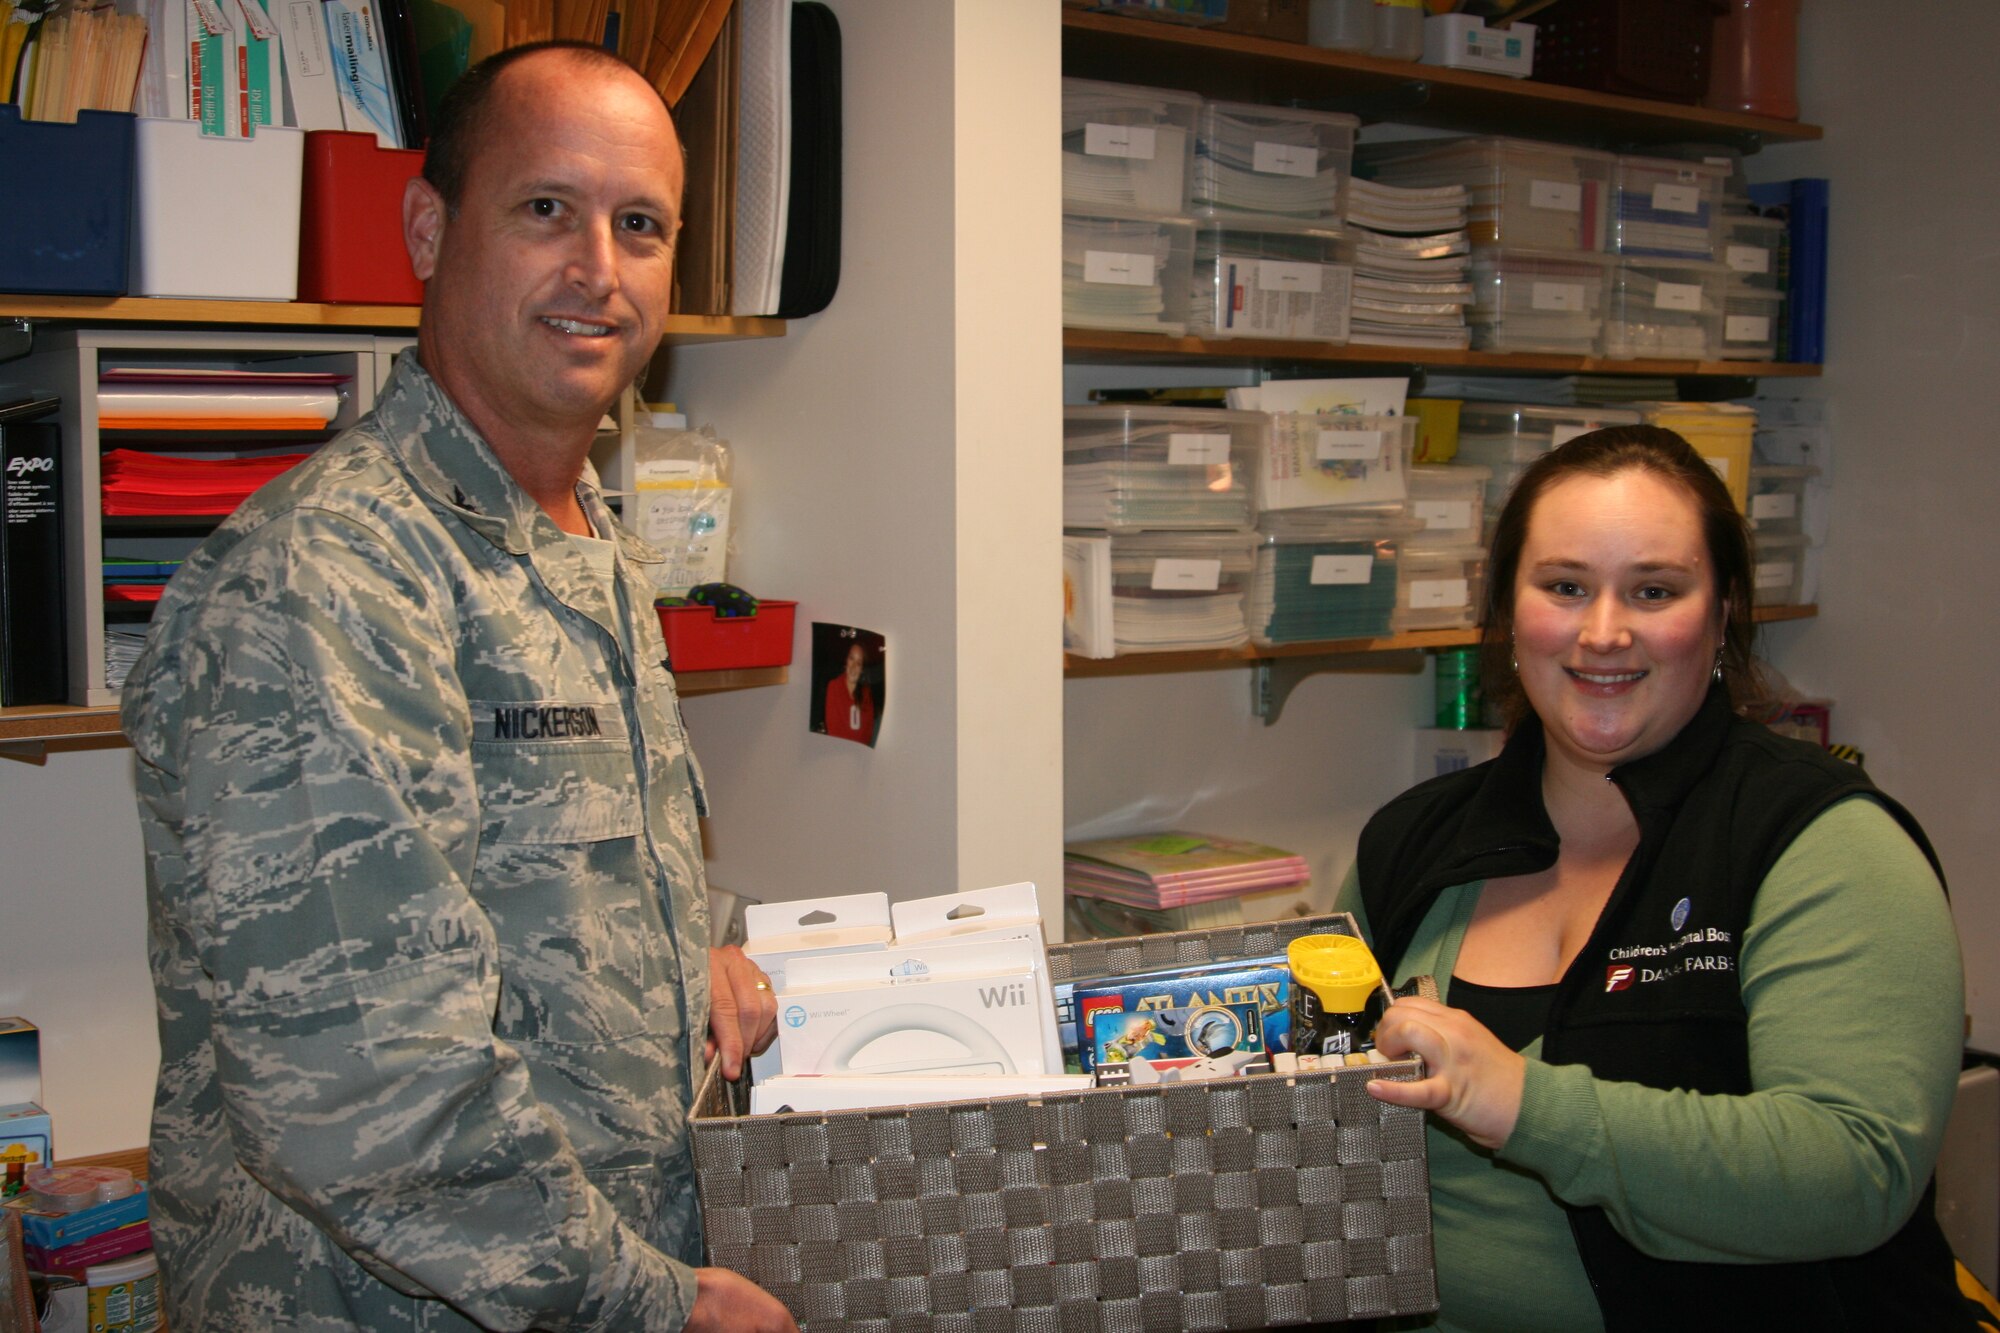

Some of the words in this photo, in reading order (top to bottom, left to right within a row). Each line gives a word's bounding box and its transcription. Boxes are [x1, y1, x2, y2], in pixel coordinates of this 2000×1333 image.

[204, 85, 215, 98] Kit
[251, 89, 262, 102] Kit
[7, 457, 53, 477] EXPO
[495, 706, 602, 739] NICKERSON
[979, 983, 1026, 1009] Wii
